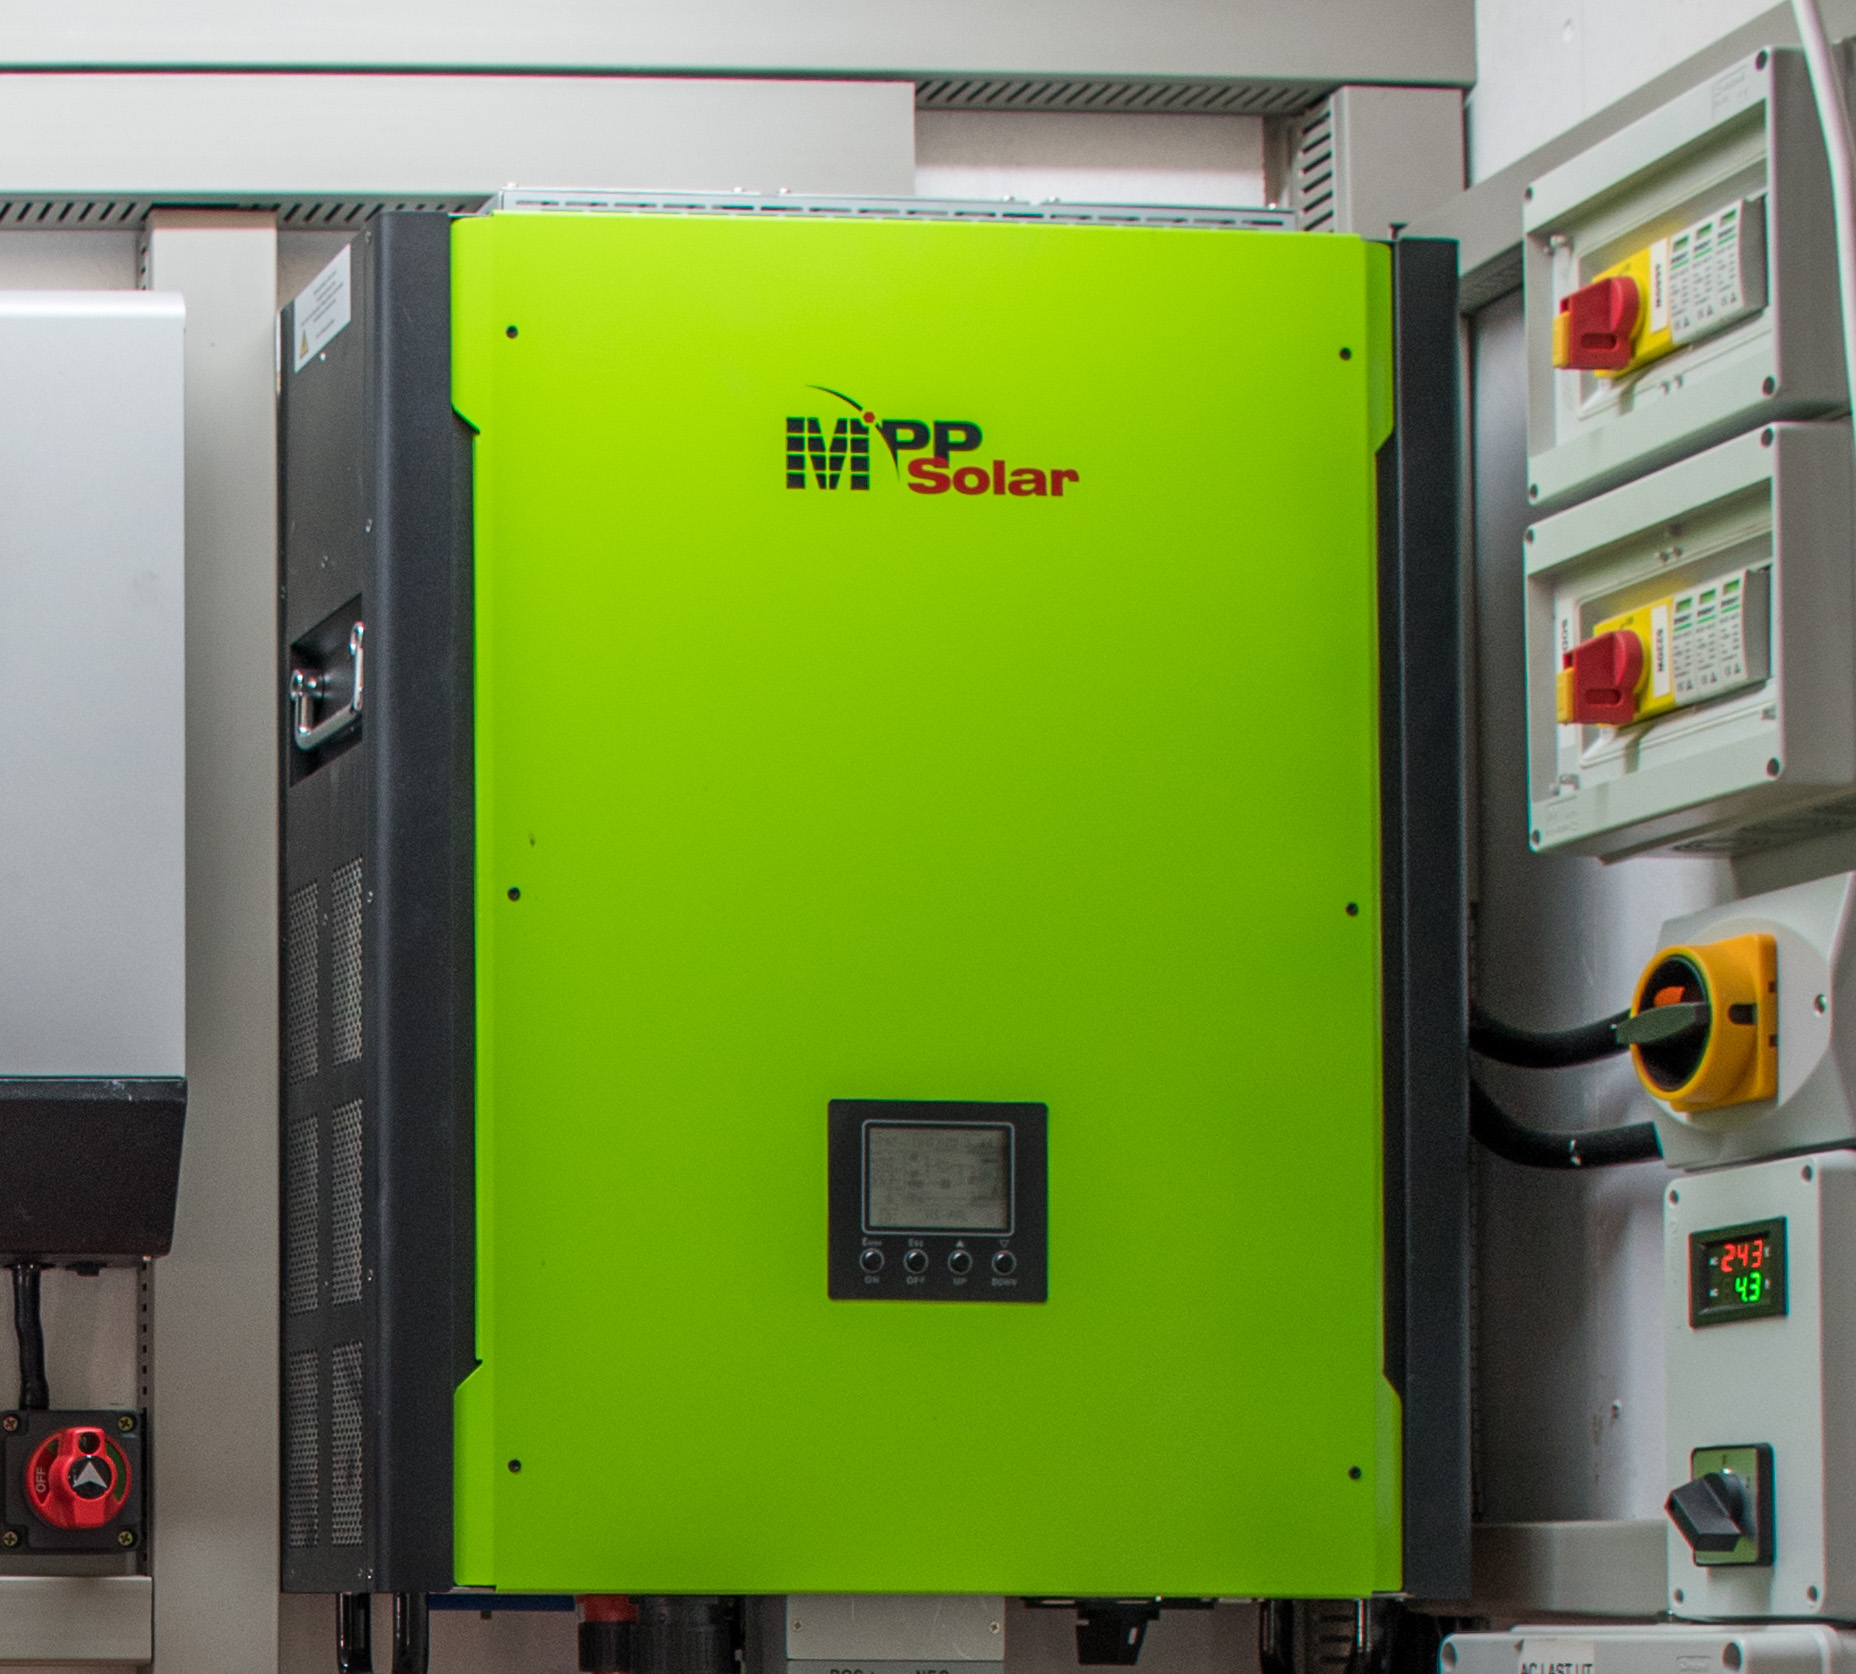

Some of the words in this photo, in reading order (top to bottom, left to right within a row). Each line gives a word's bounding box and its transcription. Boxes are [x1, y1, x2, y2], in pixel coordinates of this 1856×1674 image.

[908, 456, 1079, 496] Solar
[1721, 1239, 1763, 1272] 243
[906, 1276, 926, 1286] OFF
[953, 1277, 967, 1286] UP
[991, 1277, 1018, 1287] DOWN
[36, 1467, 46, 1493] OFF
